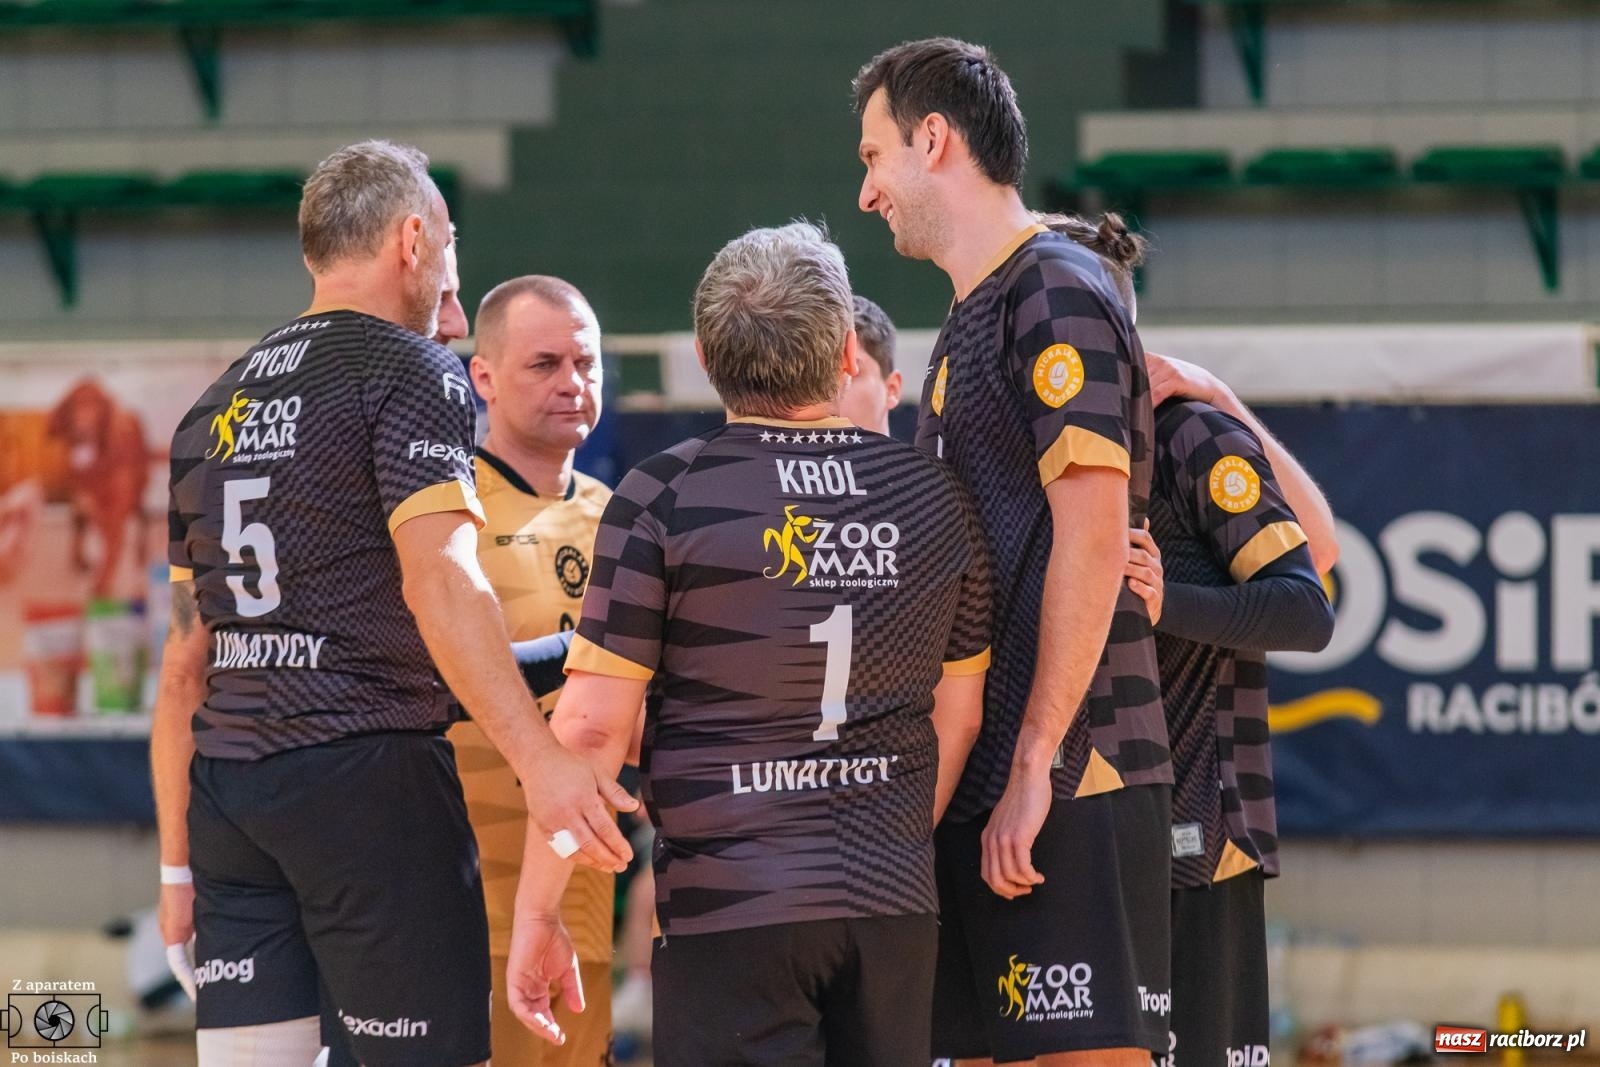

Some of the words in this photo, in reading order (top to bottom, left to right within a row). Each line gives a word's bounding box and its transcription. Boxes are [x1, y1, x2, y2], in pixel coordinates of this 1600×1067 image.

[239, 339, 312, 382] PYCIU
[241, 395, 302, 427] ZOO
[234, 422, 297, 453] MAR
[775, 455, 867, 496] KRÓL
[221, 477, 281, 618] 5
[812, 519, 900, 549] ZOO
[808, 548, 899, 577] MAR
[809, 577, 837, 589] sklep
[840, 577, 899, 589] zoologiczny
[213, 631, 327, 669] LUNATYCY
[809, 604, 852, 741] 1
[1026, 962, 1092, 990] ZOO
[1025, 986, 1093, 1013] MAR
[338, 1008, 428, 1037] exadin
[1026, 1013, 1044, 1022] sklep
[1046, 1009, 1094, 1020] zoologiczny
